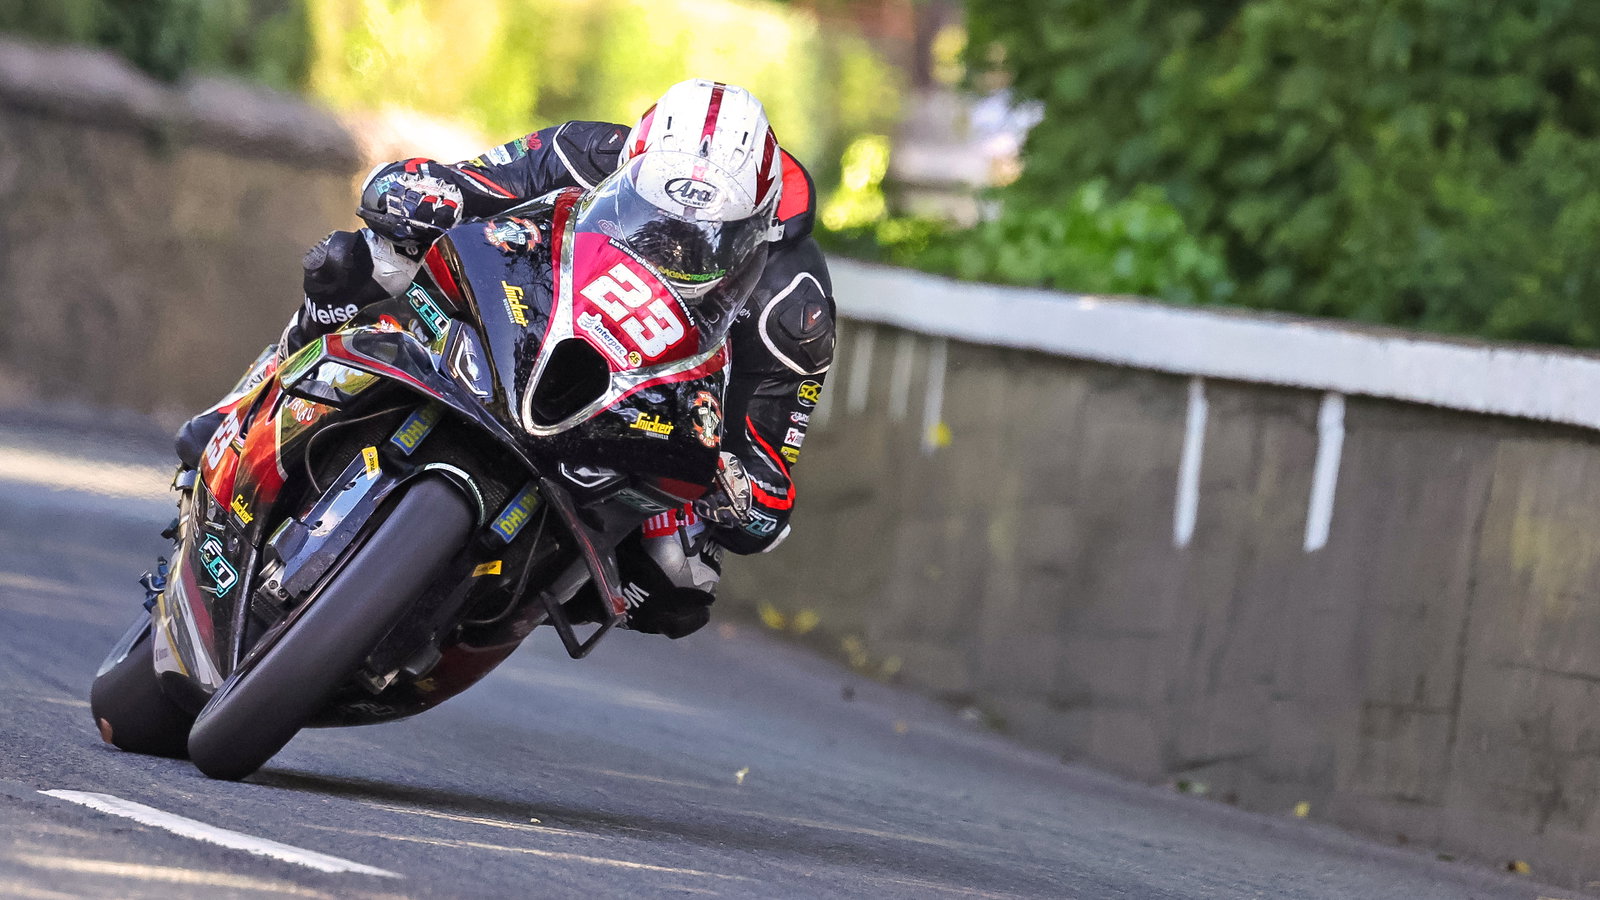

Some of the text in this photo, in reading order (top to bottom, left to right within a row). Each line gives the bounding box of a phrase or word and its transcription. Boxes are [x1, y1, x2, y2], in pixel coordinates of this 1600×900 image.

[667, 180, 717, 202] Ara
[579, 262, 686, 358] 23
[594, 323, 626, 356] interpac
[629, 352, 641, 366] 25
